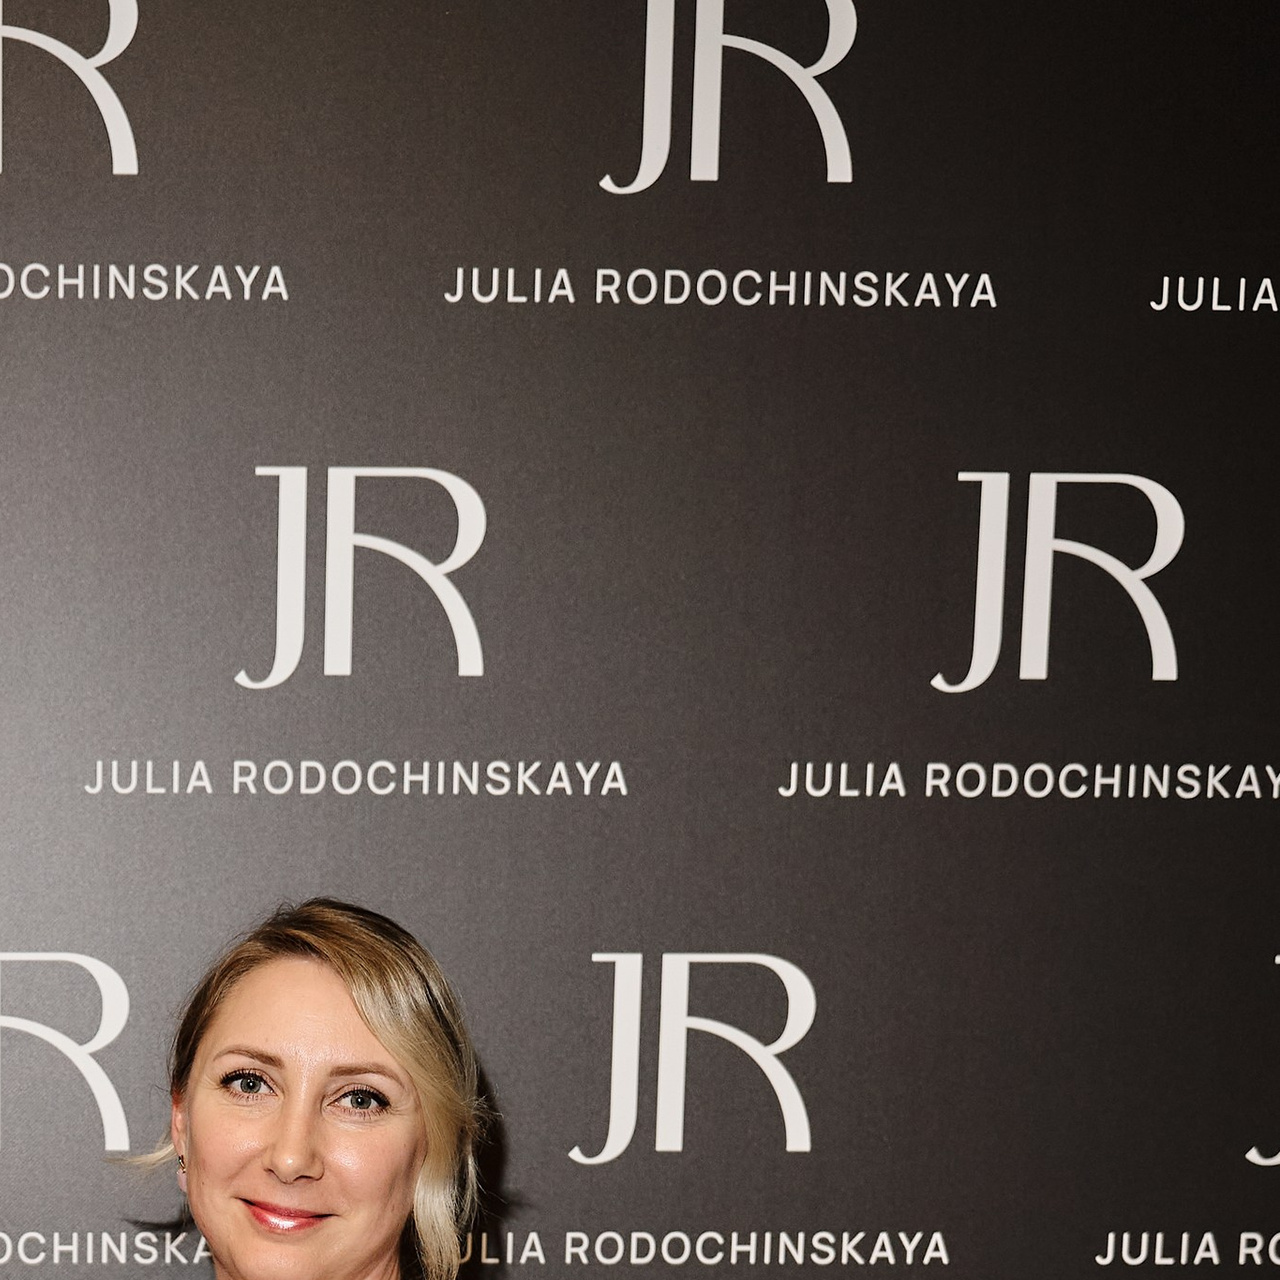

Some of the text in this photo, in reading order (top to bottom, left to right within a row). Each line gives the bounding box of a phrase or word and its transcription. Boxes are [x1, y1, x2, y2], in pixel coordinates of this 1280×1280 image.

[598, 0, 858, 195] JR
[444, 268, 996, 308] JULIA RODOCHINSKAYA
[1150, 276, 1278, 312] JULIA
[234, 466, 487, 690] JR
[930, 472, 1184, 694] JR
[84, 760, 627, 796] JULIA RODOCHINSKAYA
[778, 763, 905, 798] JULIA
[567, 953, 816, 1165] JR
[565, 1231, 949, 1265] RODOCHINSKAYA
[1095, 1231, 1220, 1266] JULIA
